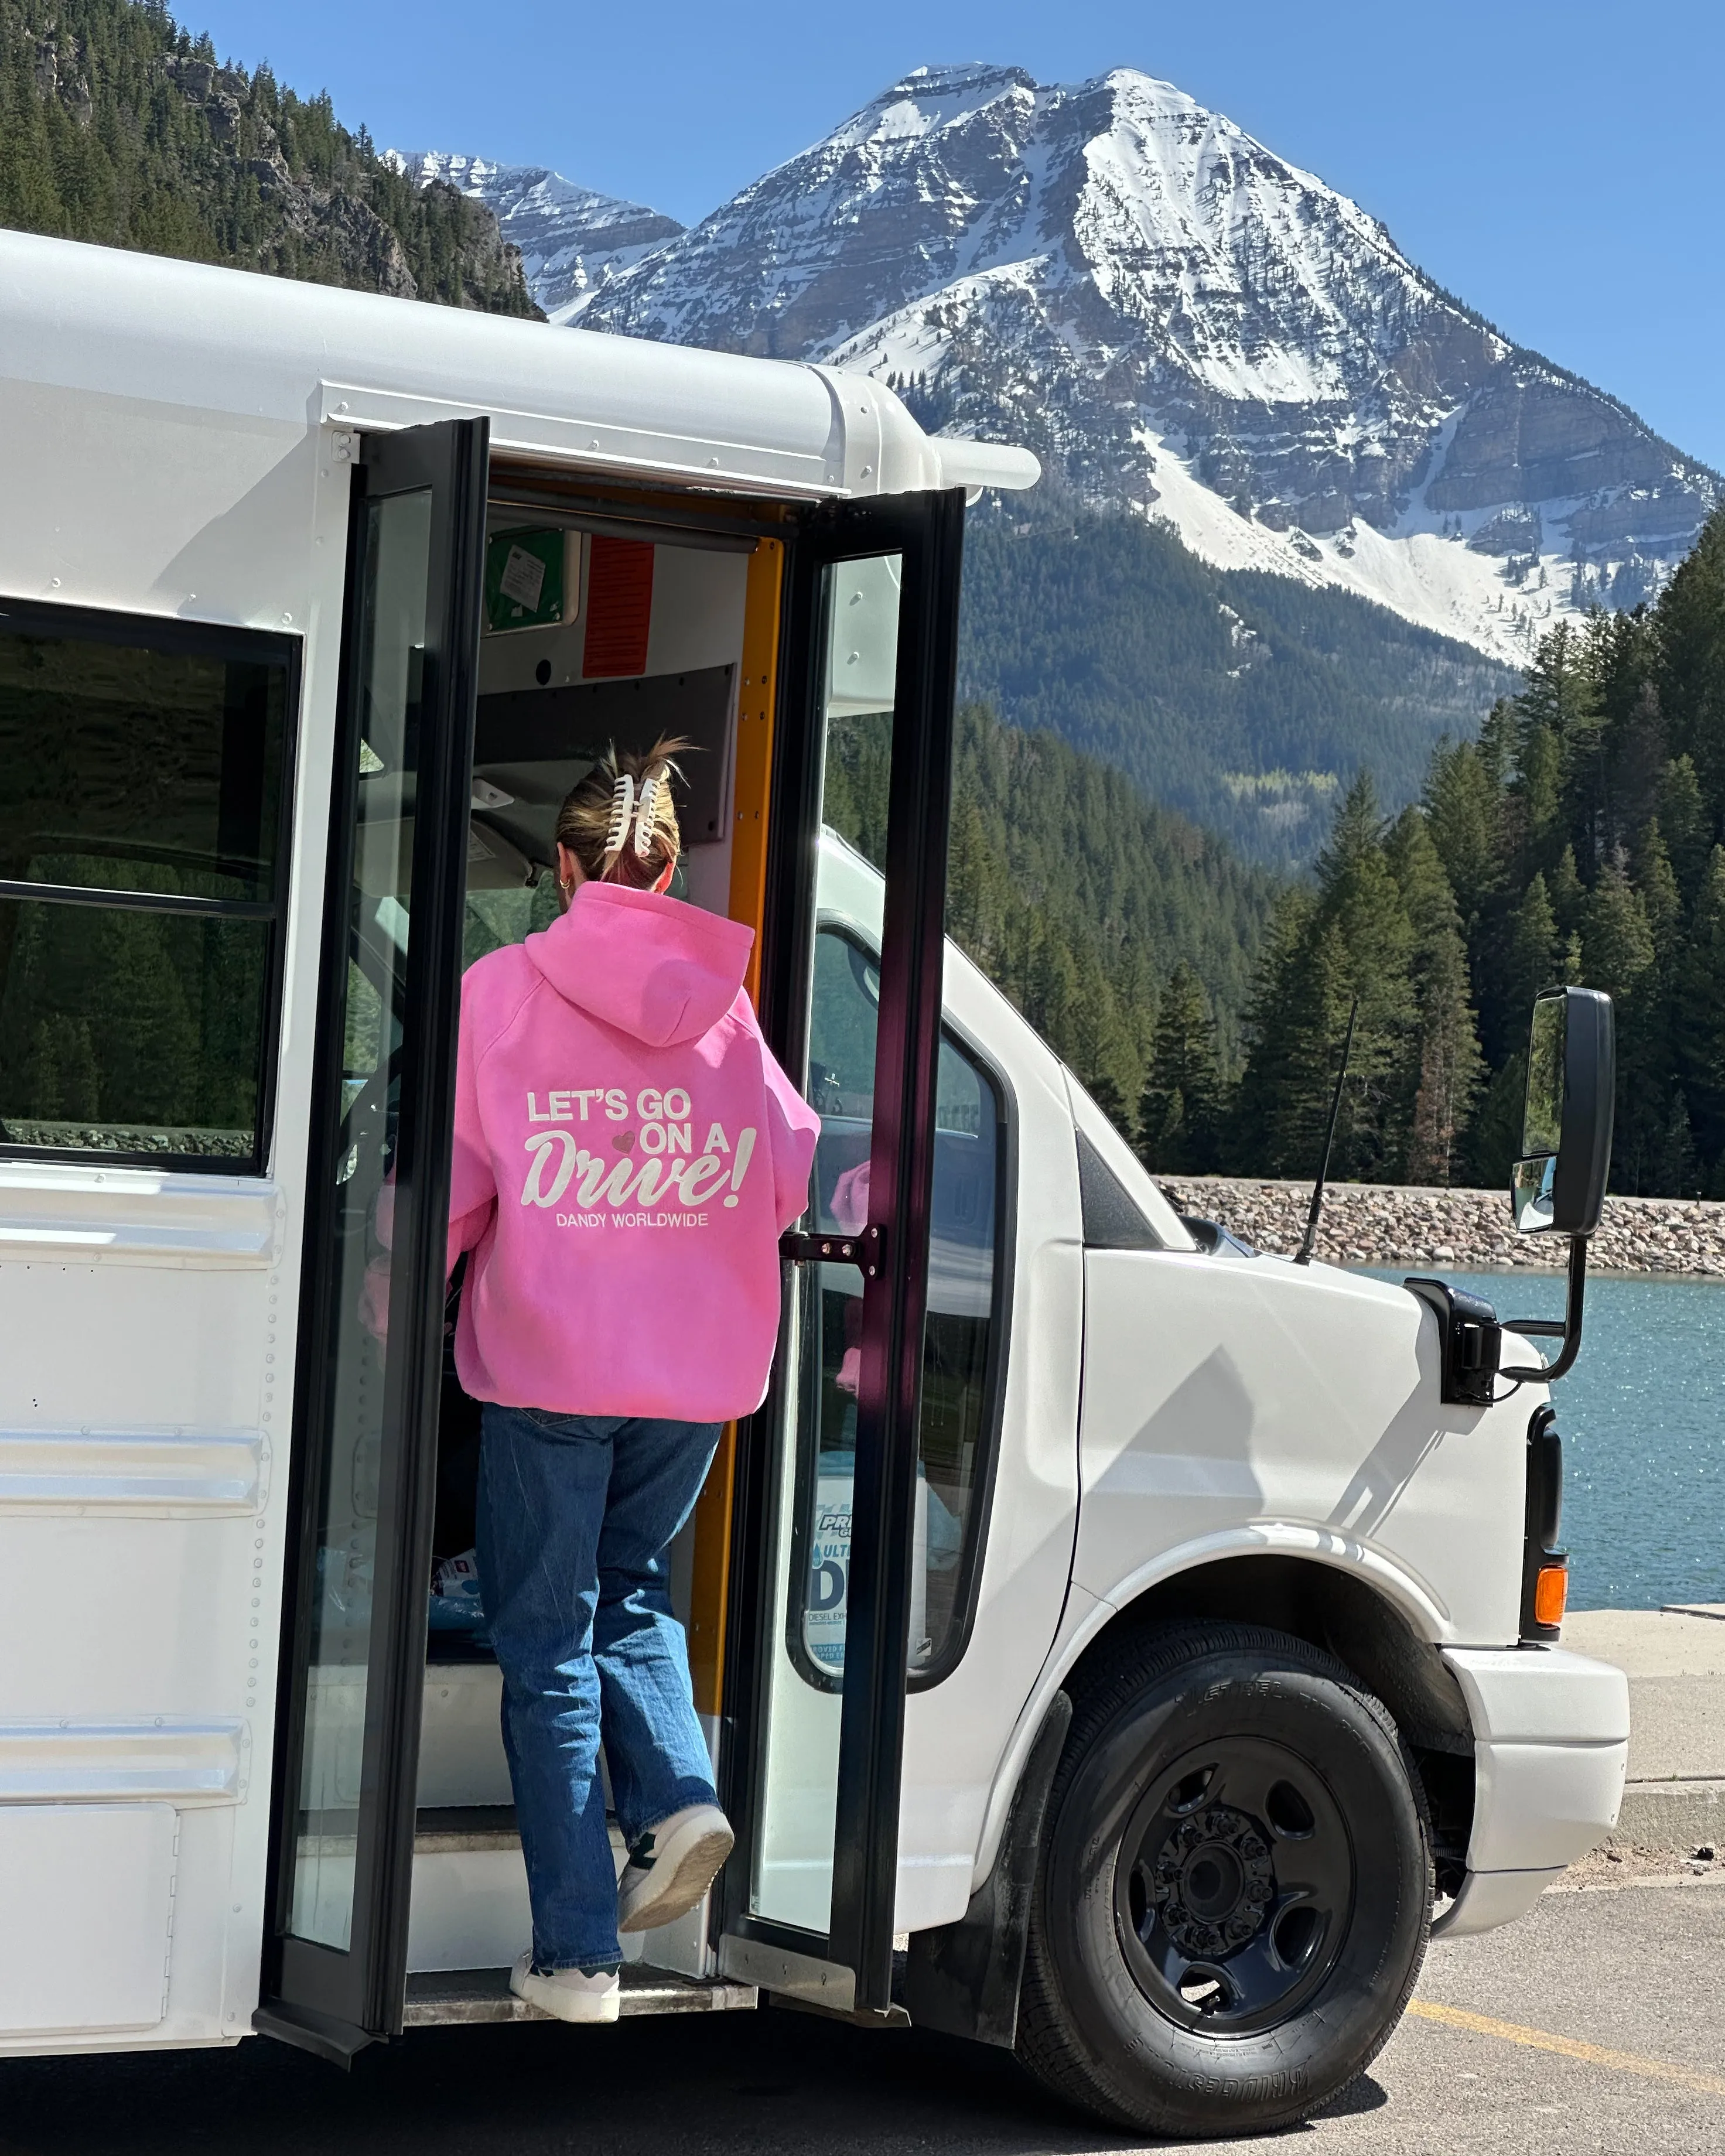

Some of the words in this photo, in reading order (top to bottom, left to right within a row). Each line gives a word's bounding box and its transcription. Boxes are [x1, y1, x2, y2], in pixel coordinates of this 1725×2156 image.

[527, 1088, 628, 1122] LET'S
[637, 1088, 691, 1120] GO
[639, 1122, 691, 1154] ON
[703, 1122, 730, 1153] A
[521, 1127, 756, 1208] Drive!
[556, 1213, 606, 1228] DANDY
[612, 1212, 709, 1228] WORLDWIDE
[808, 1612, 831, 1621] DIESEL
